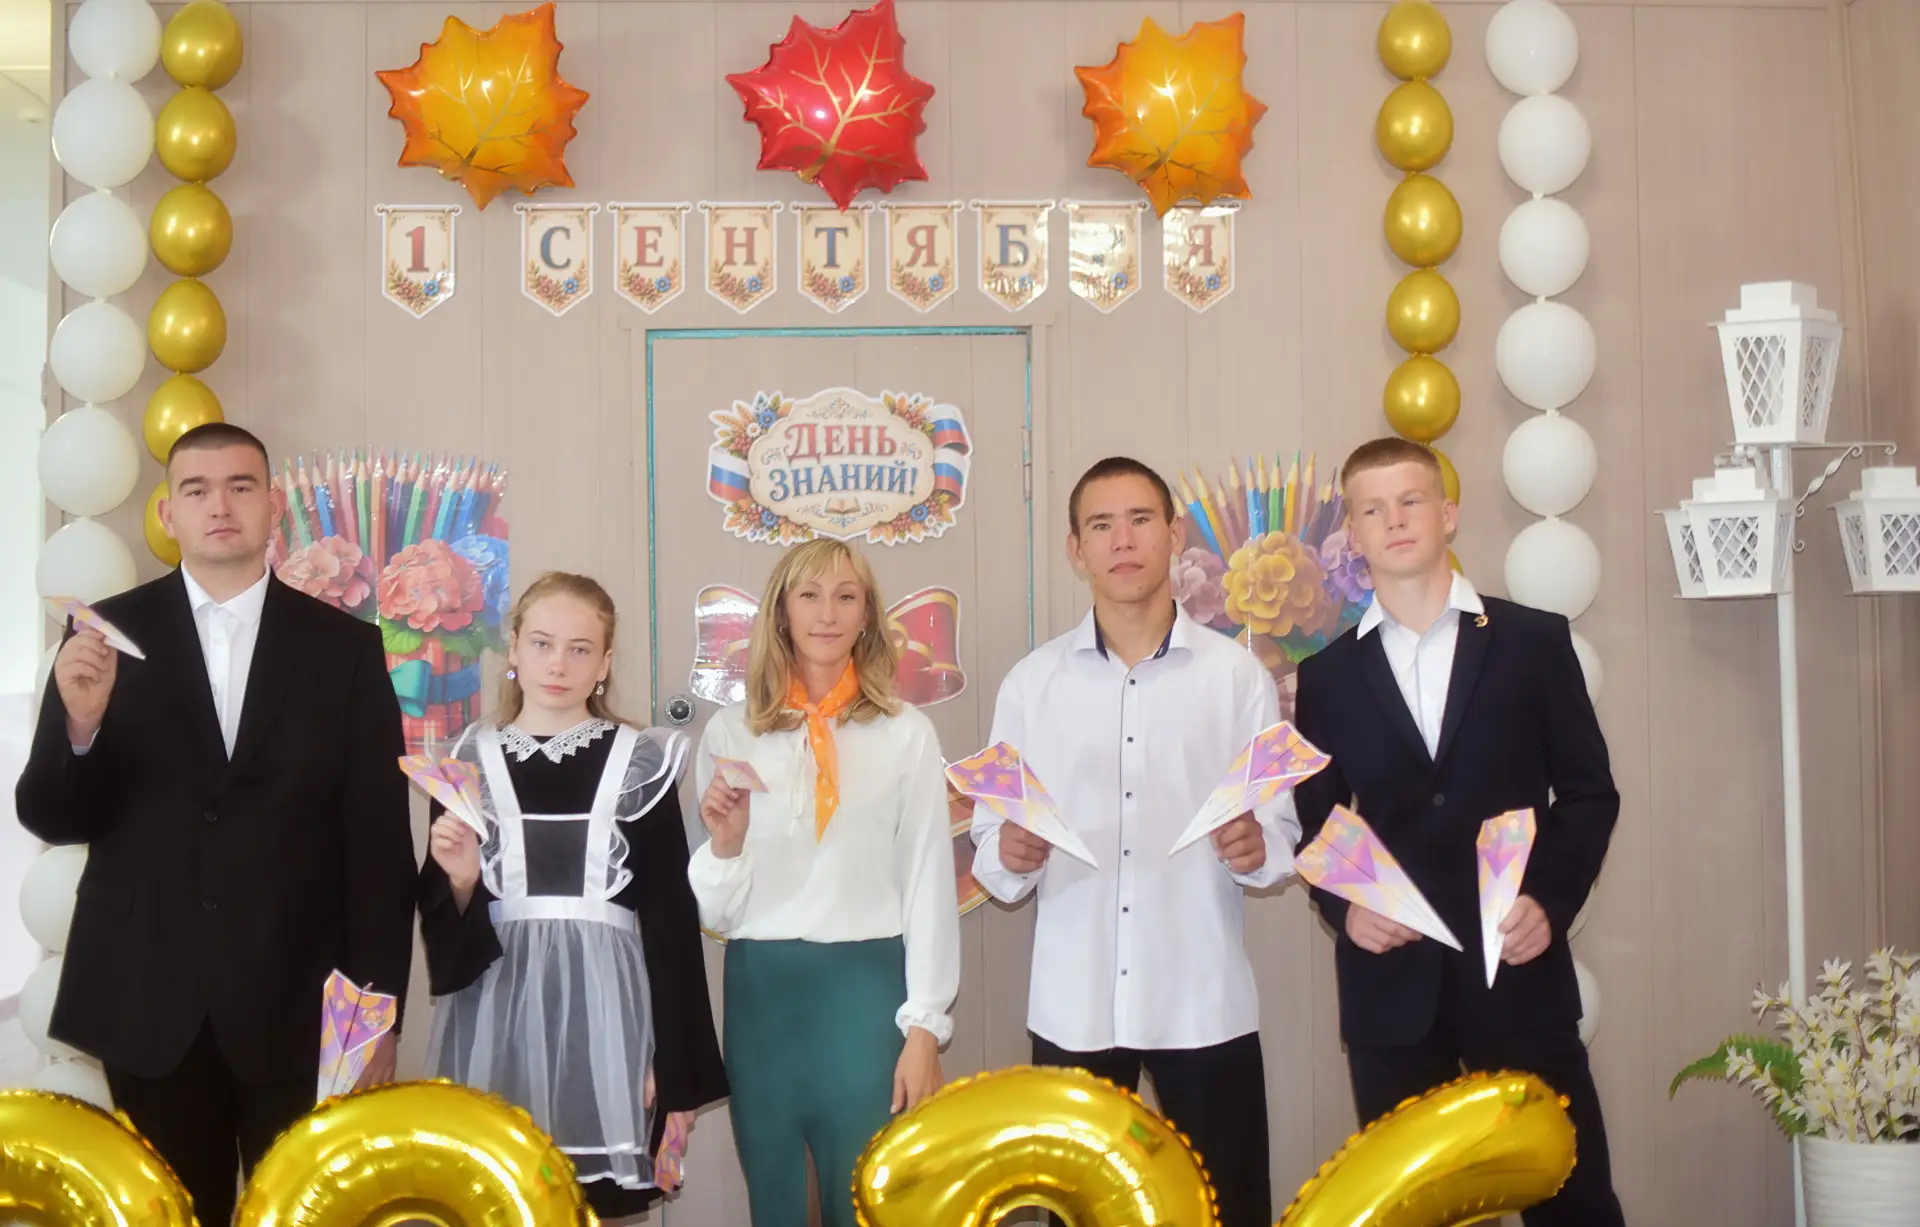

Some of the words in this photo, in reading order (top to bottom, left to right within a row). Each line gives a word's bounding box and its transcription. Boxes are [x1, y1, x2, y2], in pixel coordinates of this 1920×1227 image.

[404, 225, 431, 273] 1
[539, 223, 1217, 270] СЕНТЯБЯ
[784, 422, 897, 465] ДЕНЬ
[768, 459, 918, 502] ЗНАНИЙ!
